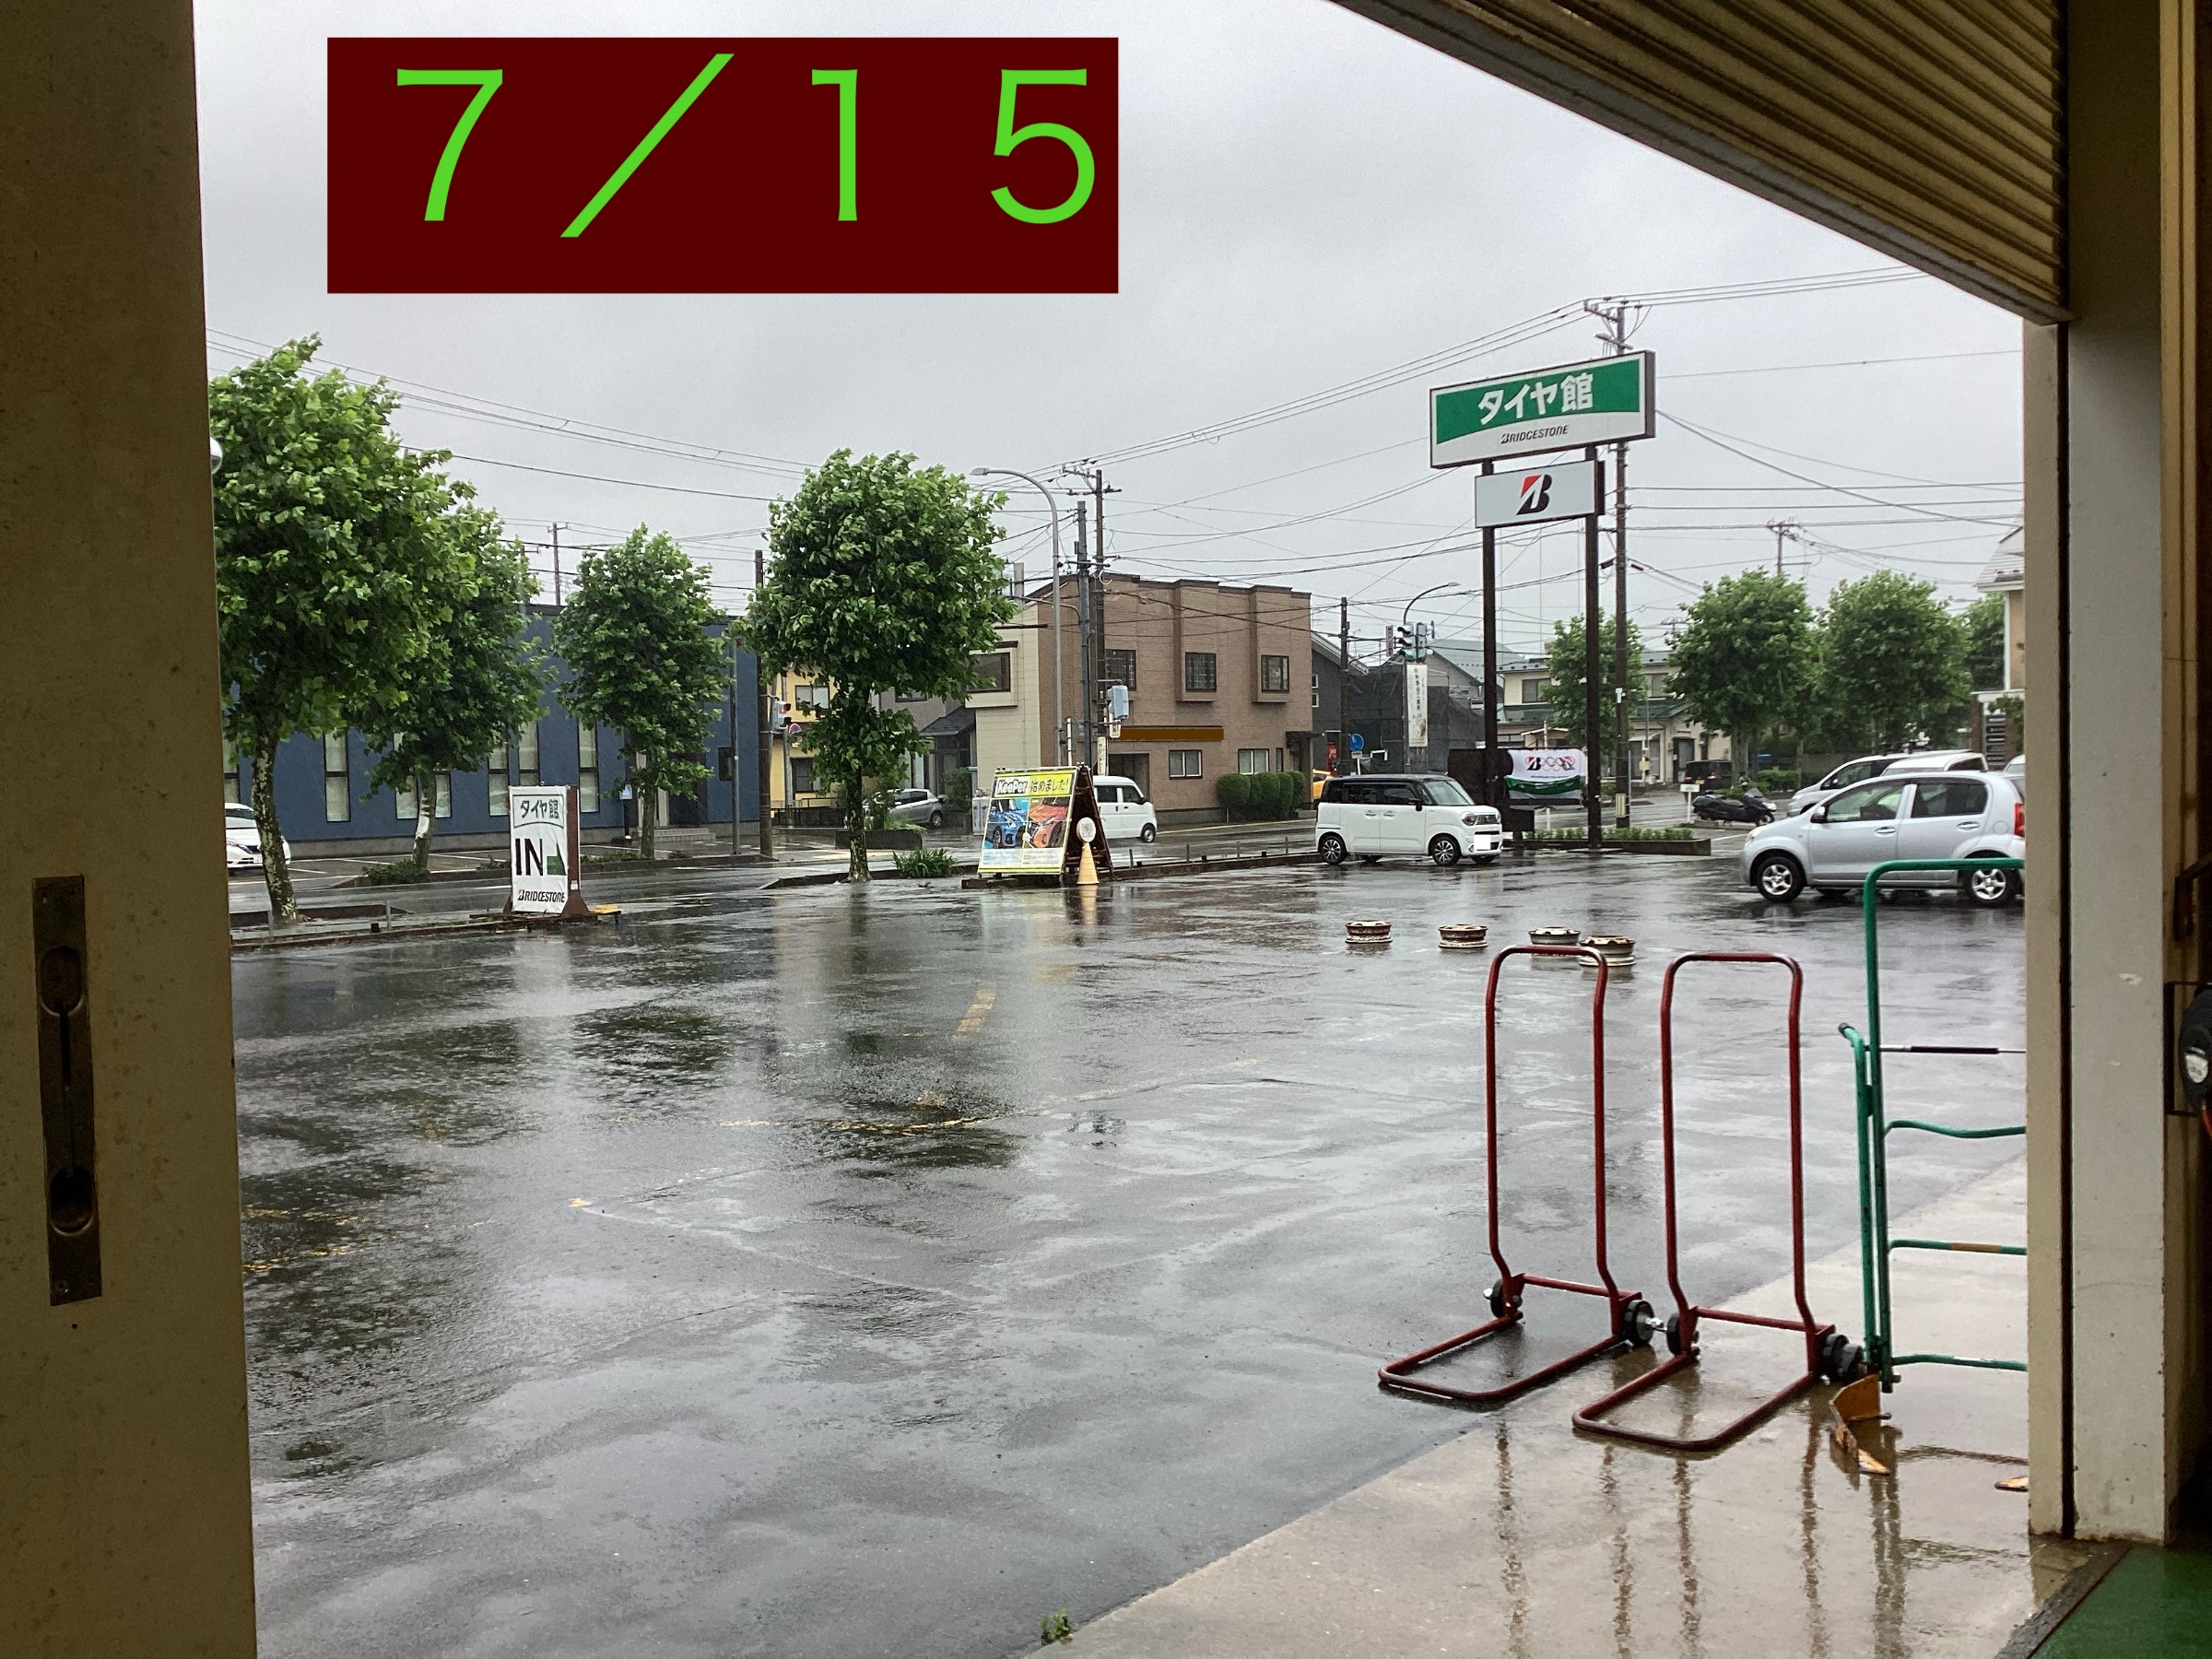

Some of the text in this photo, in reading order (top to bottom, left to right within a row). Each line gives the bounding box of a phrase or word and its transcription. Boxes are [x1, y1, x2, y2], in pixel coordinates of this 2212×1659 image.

[1477, 372, 1594, 426] タイヤ館
[1500, 424, 1569, 444] BRIDGESTONE
[997, 779, 1028, 794] KeePer
[520, 798, 559, 819] タイヤ館
[514, 838, 544, 877] IN
[517, 888, 565, 903] BRIDGESTONE
